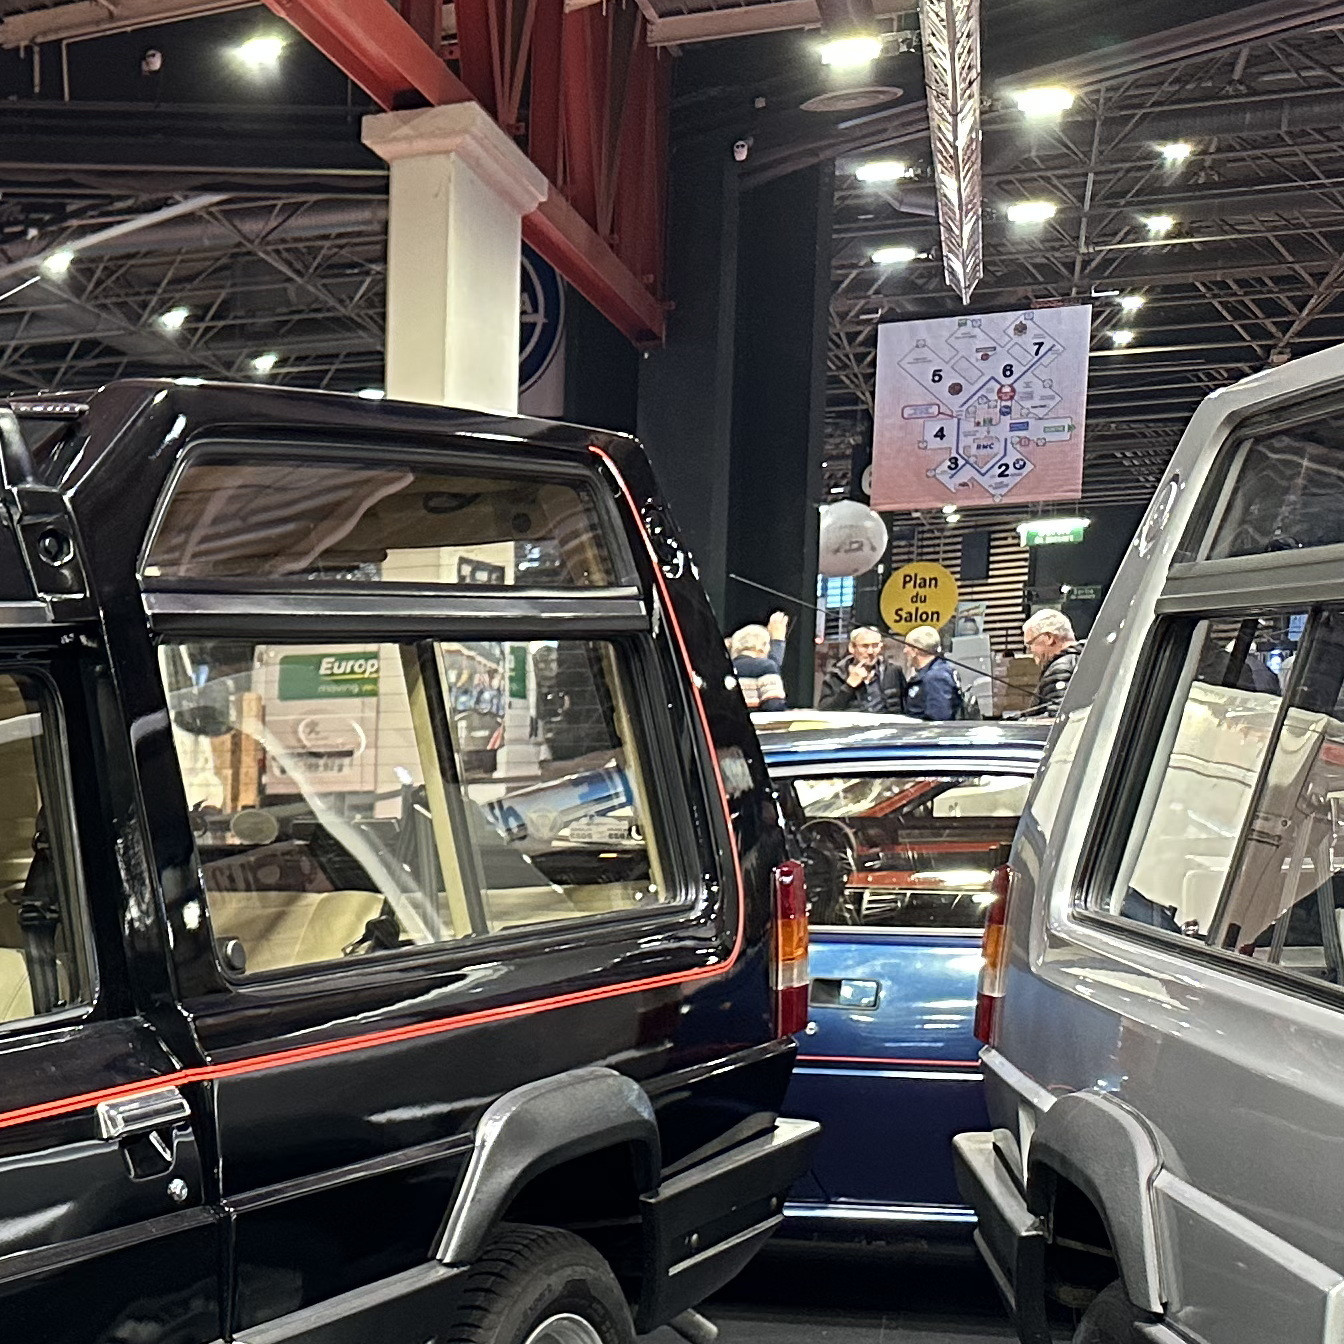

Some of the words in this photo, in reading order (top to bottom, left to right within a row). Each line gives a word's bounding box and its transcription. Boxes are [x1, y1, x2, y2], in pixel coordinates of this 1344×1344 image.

[1032, 341, 1044, 356] 7
[931, 369, 943, 383] 5
[1002, 364, 1014, 378] 6
[933, 426, 946, 441] 4
[947, 456, 959, 471] 3
[997, 463, 1010, 478] 2
[902, 573, 939, 589] Plan
[911, 591, 927, 604] du
[893, 607, 941, 623] Salon
